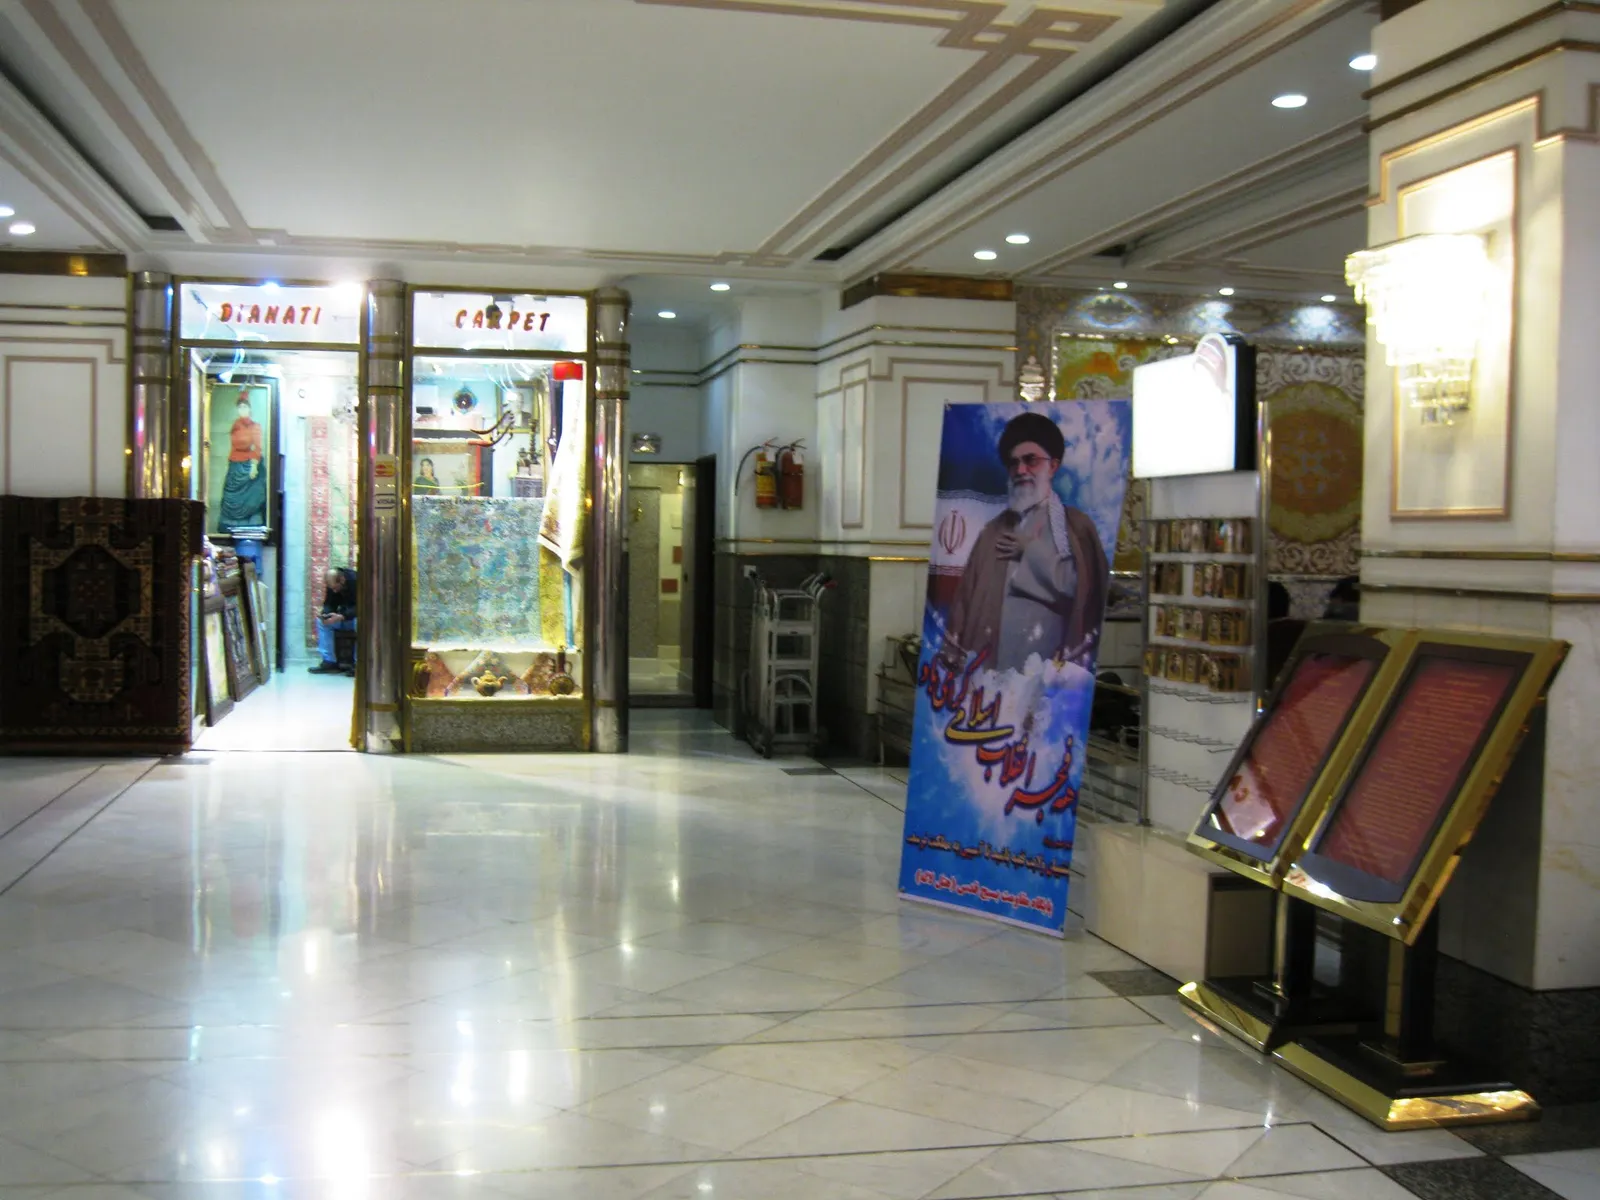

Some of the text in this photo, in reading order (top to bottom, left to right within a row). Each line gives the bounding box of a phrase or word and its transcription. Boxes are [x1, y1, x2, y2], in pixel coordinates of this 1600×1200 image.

[220, 303, 550, 331] DIANATI CARPET
[945, 686, 1015, 744] اسلامی
[977, 733, 1037, 788] انقلاب
[1004, 734, 1074, 827] فجر
